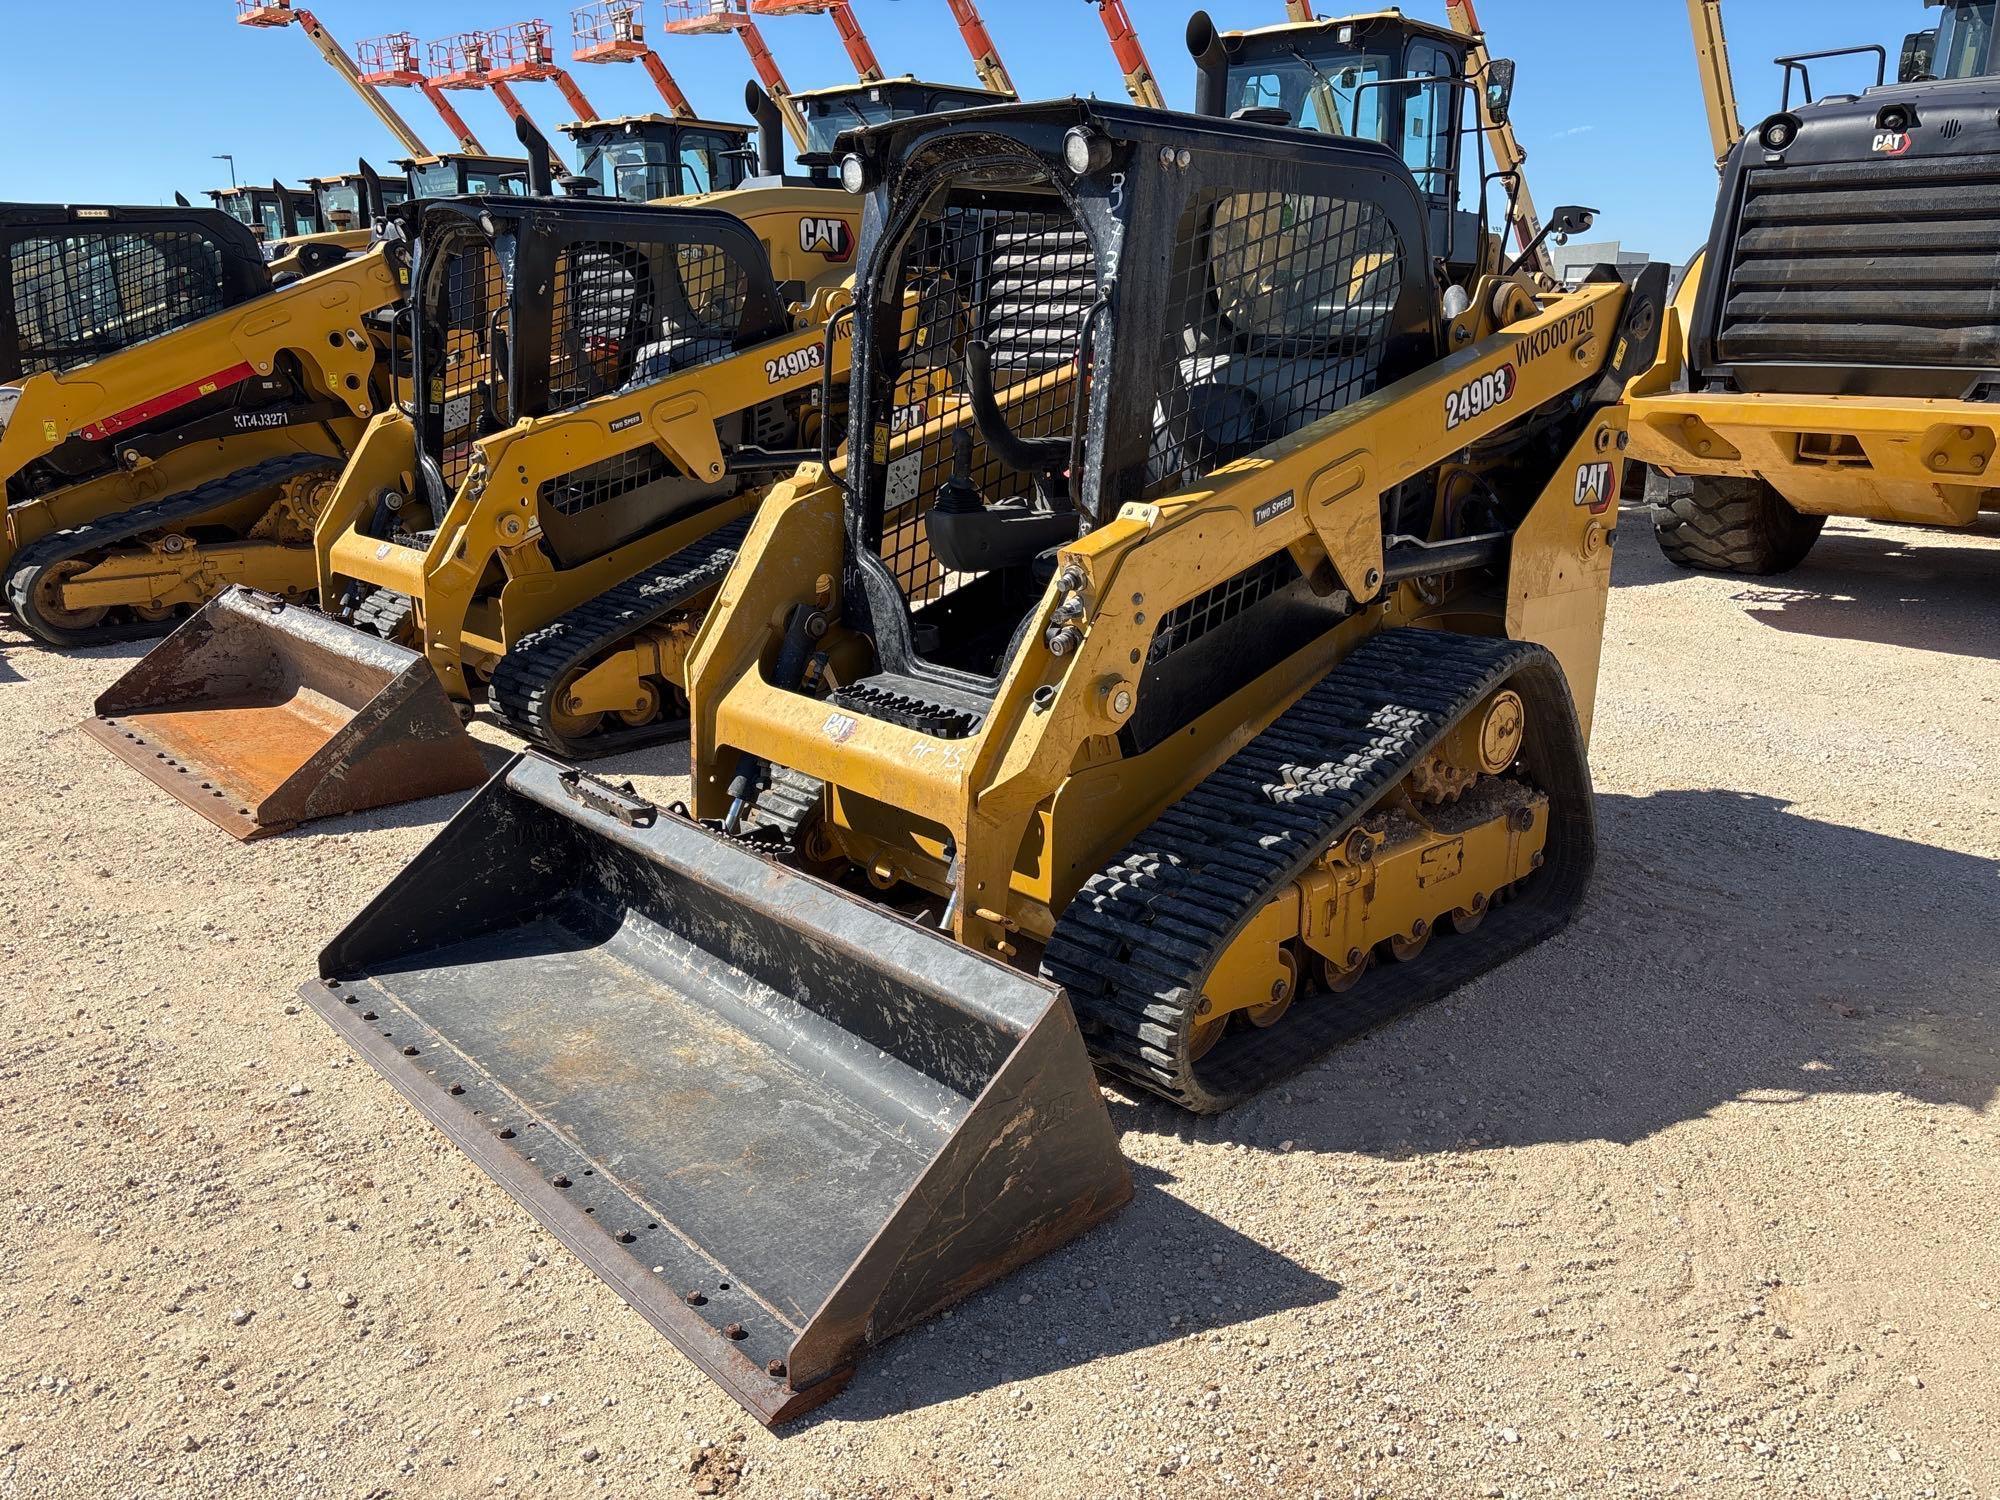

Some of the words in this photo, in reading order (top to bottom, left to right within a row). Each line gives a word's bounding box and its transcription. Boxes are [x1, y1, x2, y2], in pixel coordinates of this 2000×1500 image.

[1872, 133, 1903, 152] CAT
[800, 217, 842, 253] CAT
[1515, 305, 1595, 367] WKD00720
[765, 345, 821, 384] 249D3
[1446, 367, 1507, 430] 249D3
[1574, 462, 1610, 505] CAT
